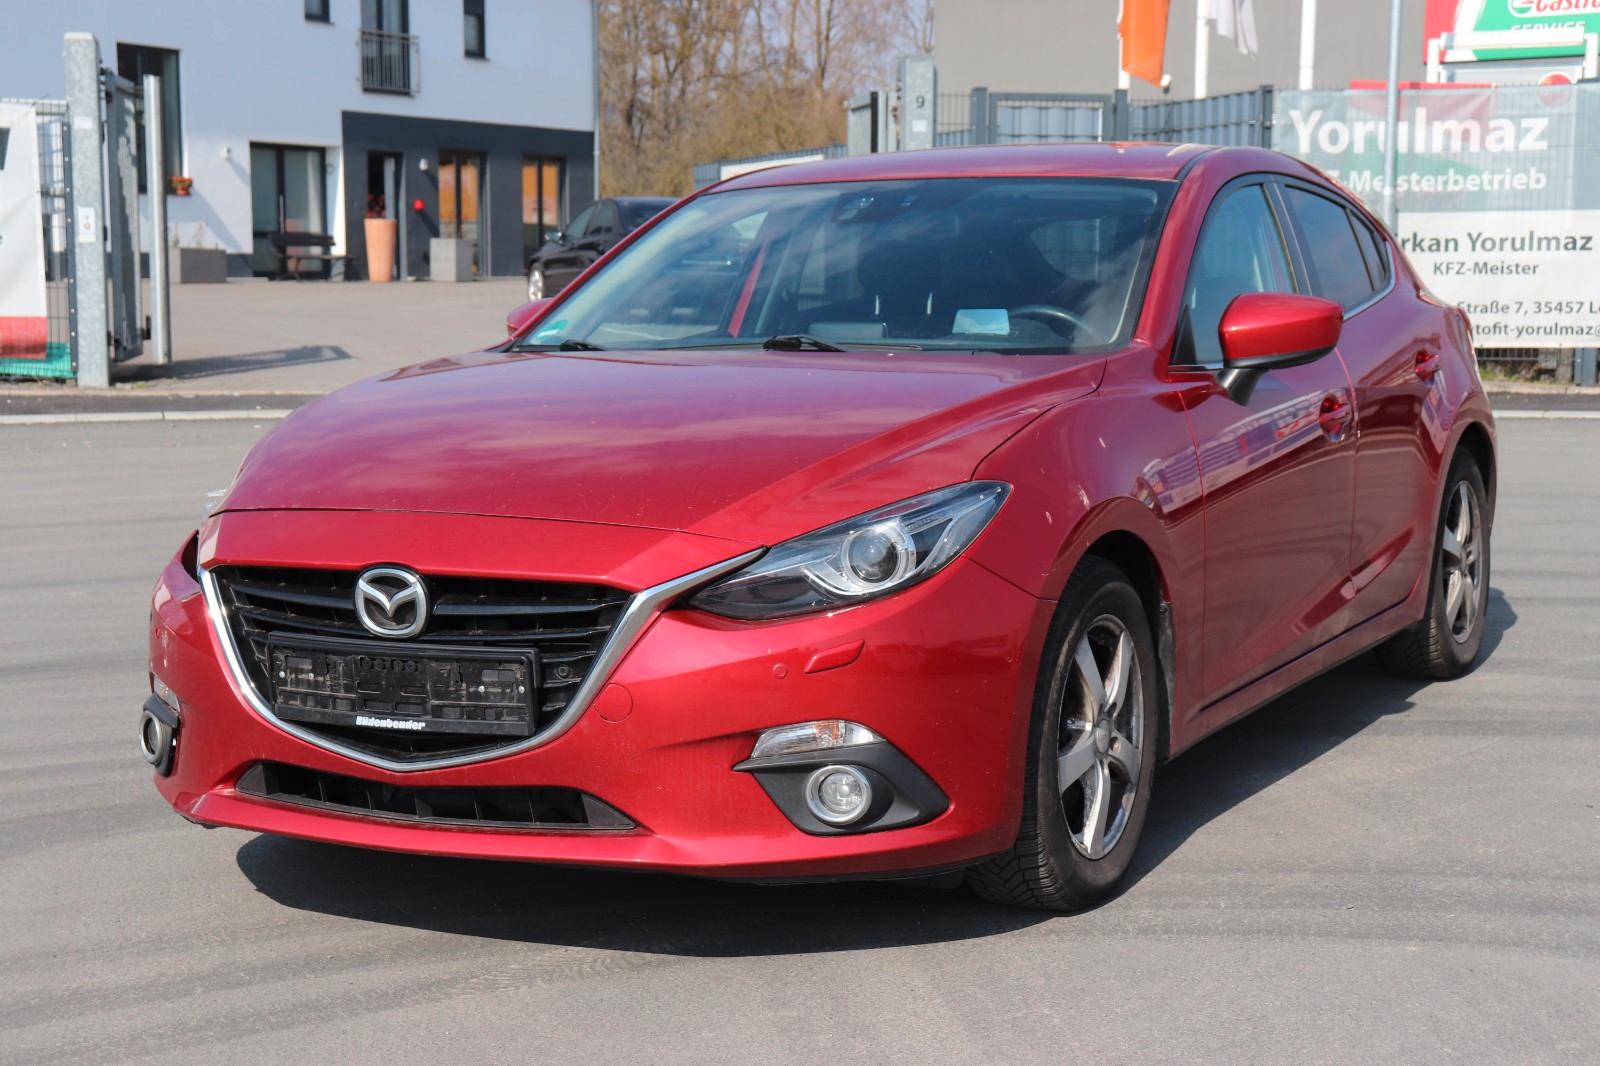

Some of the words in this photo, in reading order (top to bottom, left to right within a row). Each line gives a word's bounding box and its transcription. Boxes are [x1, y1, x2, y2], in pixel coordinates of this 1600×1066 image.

[916, 95, 925, 109] 9
[1289, 107, 1549, 154] Yorulmaz
[1395, 231, 1458, 252] rkan
[1467, 230, 1593, 253] Yorulmaz
[1433, 261, 1540, 276] KFZ-Meister
[1515, 302, 1528, 316] 7,
[1533, 301, 1584, 314] 35457
[1590, 300, 1600, 314] L
[1472, 321, 1600, 339] tofit-yorulmaz
